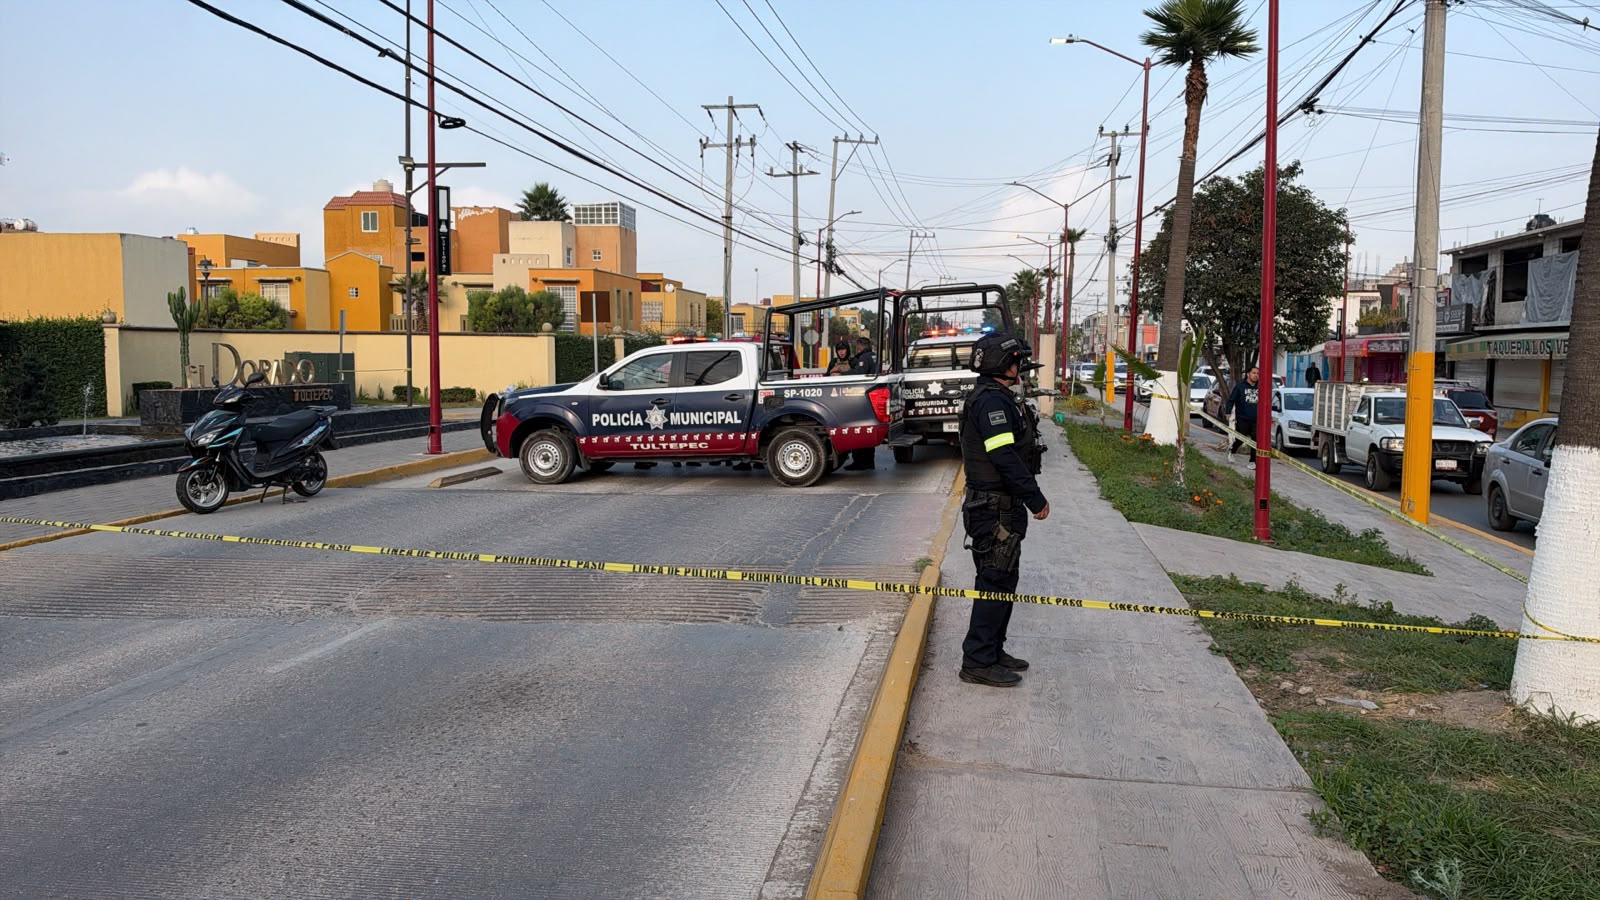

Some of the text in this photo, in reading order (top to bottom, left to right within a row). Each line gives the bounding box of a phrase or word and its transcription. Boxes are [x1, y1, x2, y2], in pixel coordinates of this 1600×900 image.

[1487, 340, 1530, 354] TAQUERIA
[1532, 340, 1551, 354] LOS
[212, 343, 315, 388] DORADO
[294, 388, 334, 402] TULTEPEC
[784, 388, 822, 398] SP-1020
[592, 410, 742, 426] POLICÍA MUNICIPAL
[630, 442, 709, 450] TULTEPEC
[494, 555, 605, 570] PROHIBIDO EL PASO
[632, 564, 728, 580] LINEA DE POLICIA
[741, 572, 848, 588] PROHIBIDO EL PASO
[875, 583, 966, 598] LINEA DE POLICIA
[979, 592, 1083, 608] PROHIBIDO EL PASO
[1108, 602, 1140, 612] LINEA
